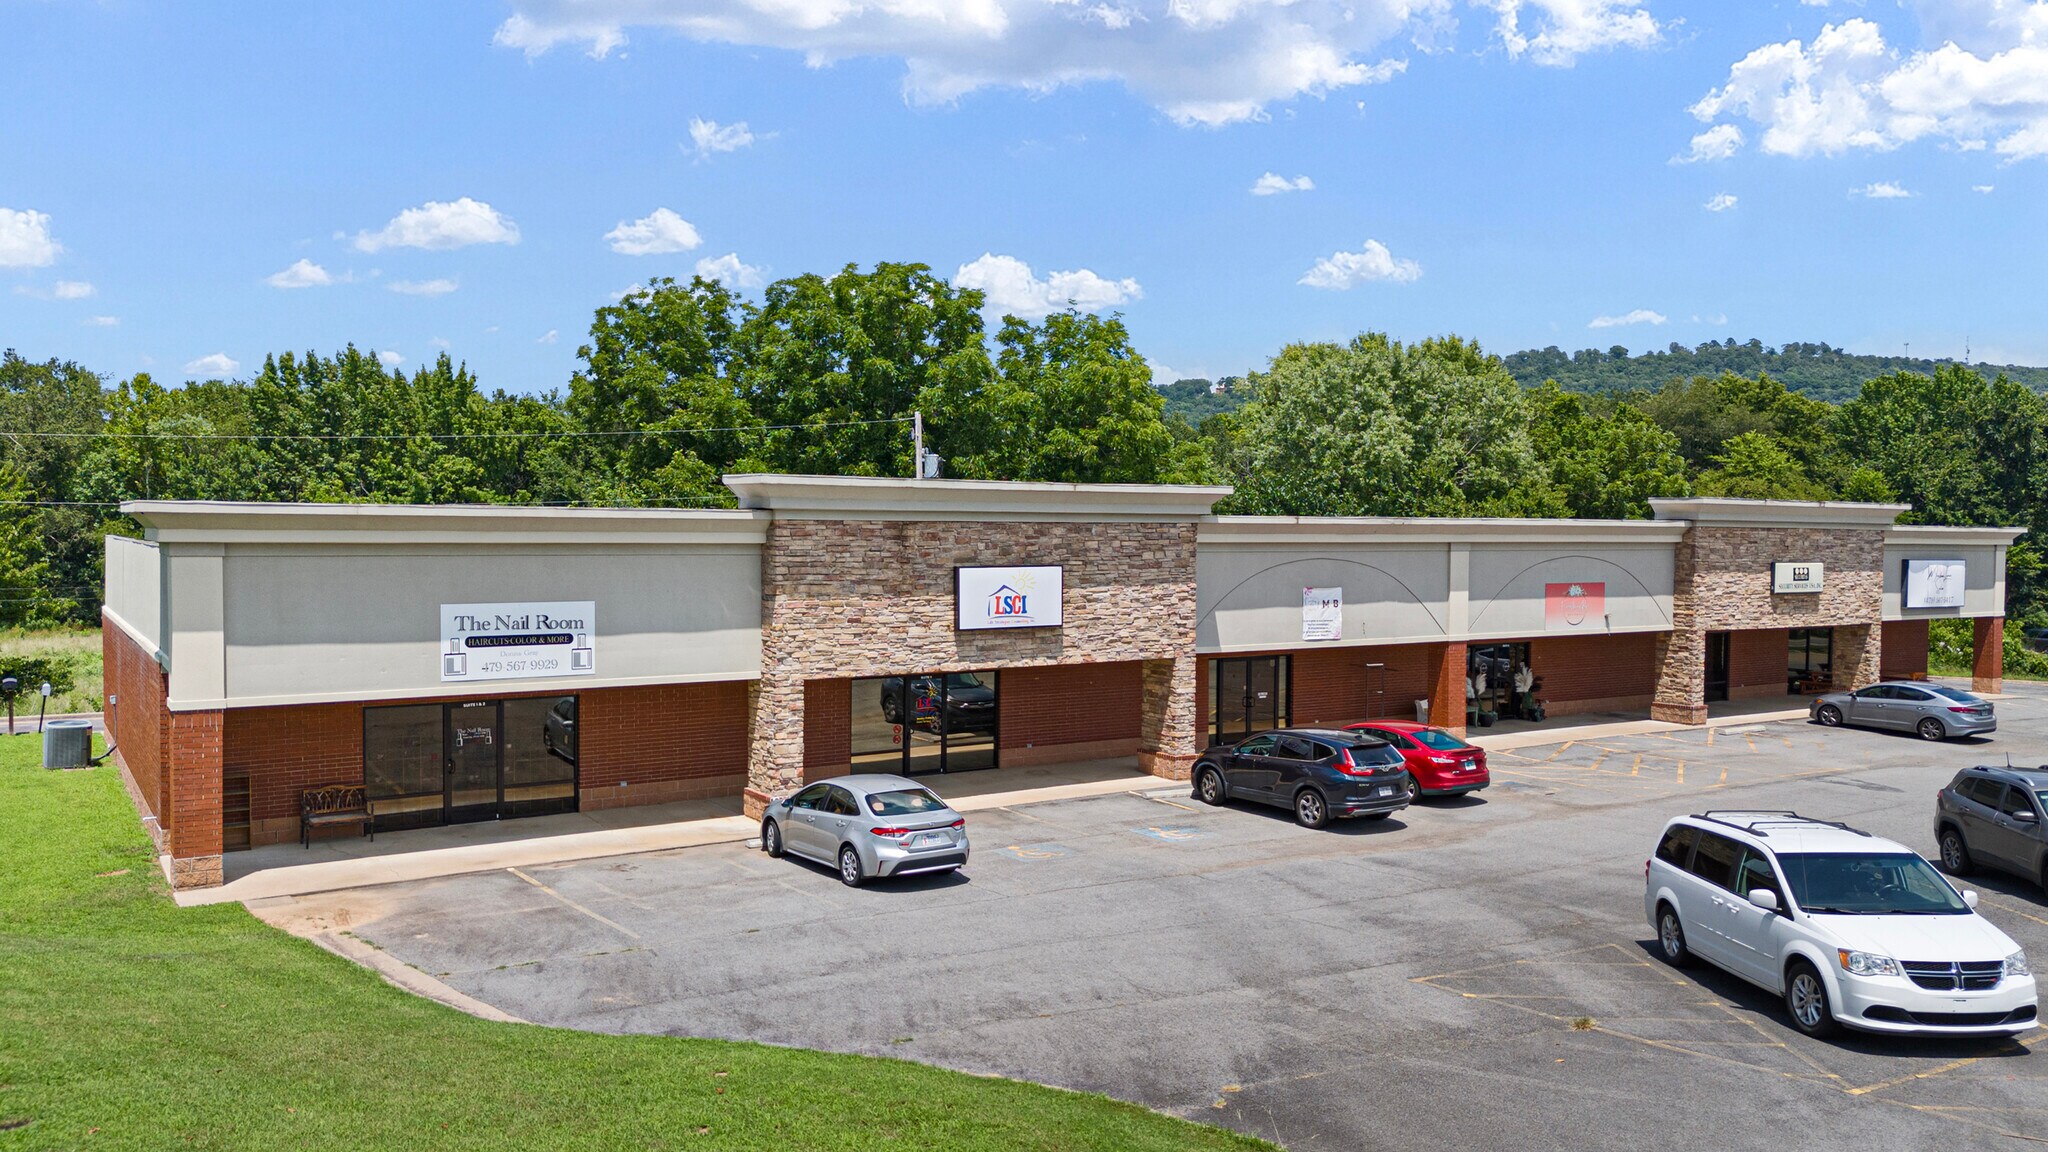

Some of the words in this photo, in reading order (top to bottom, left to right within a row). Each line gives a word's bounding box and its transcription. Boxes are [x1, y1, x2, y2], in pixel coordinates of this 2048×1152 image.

[995, 595, 1027, 615] LSCI
[454, 615, 491, 631] The
[494, 614, 529, 631] Nail
[536, 614, 584, 630] Room
[546, 635, 569, 643] MORE
